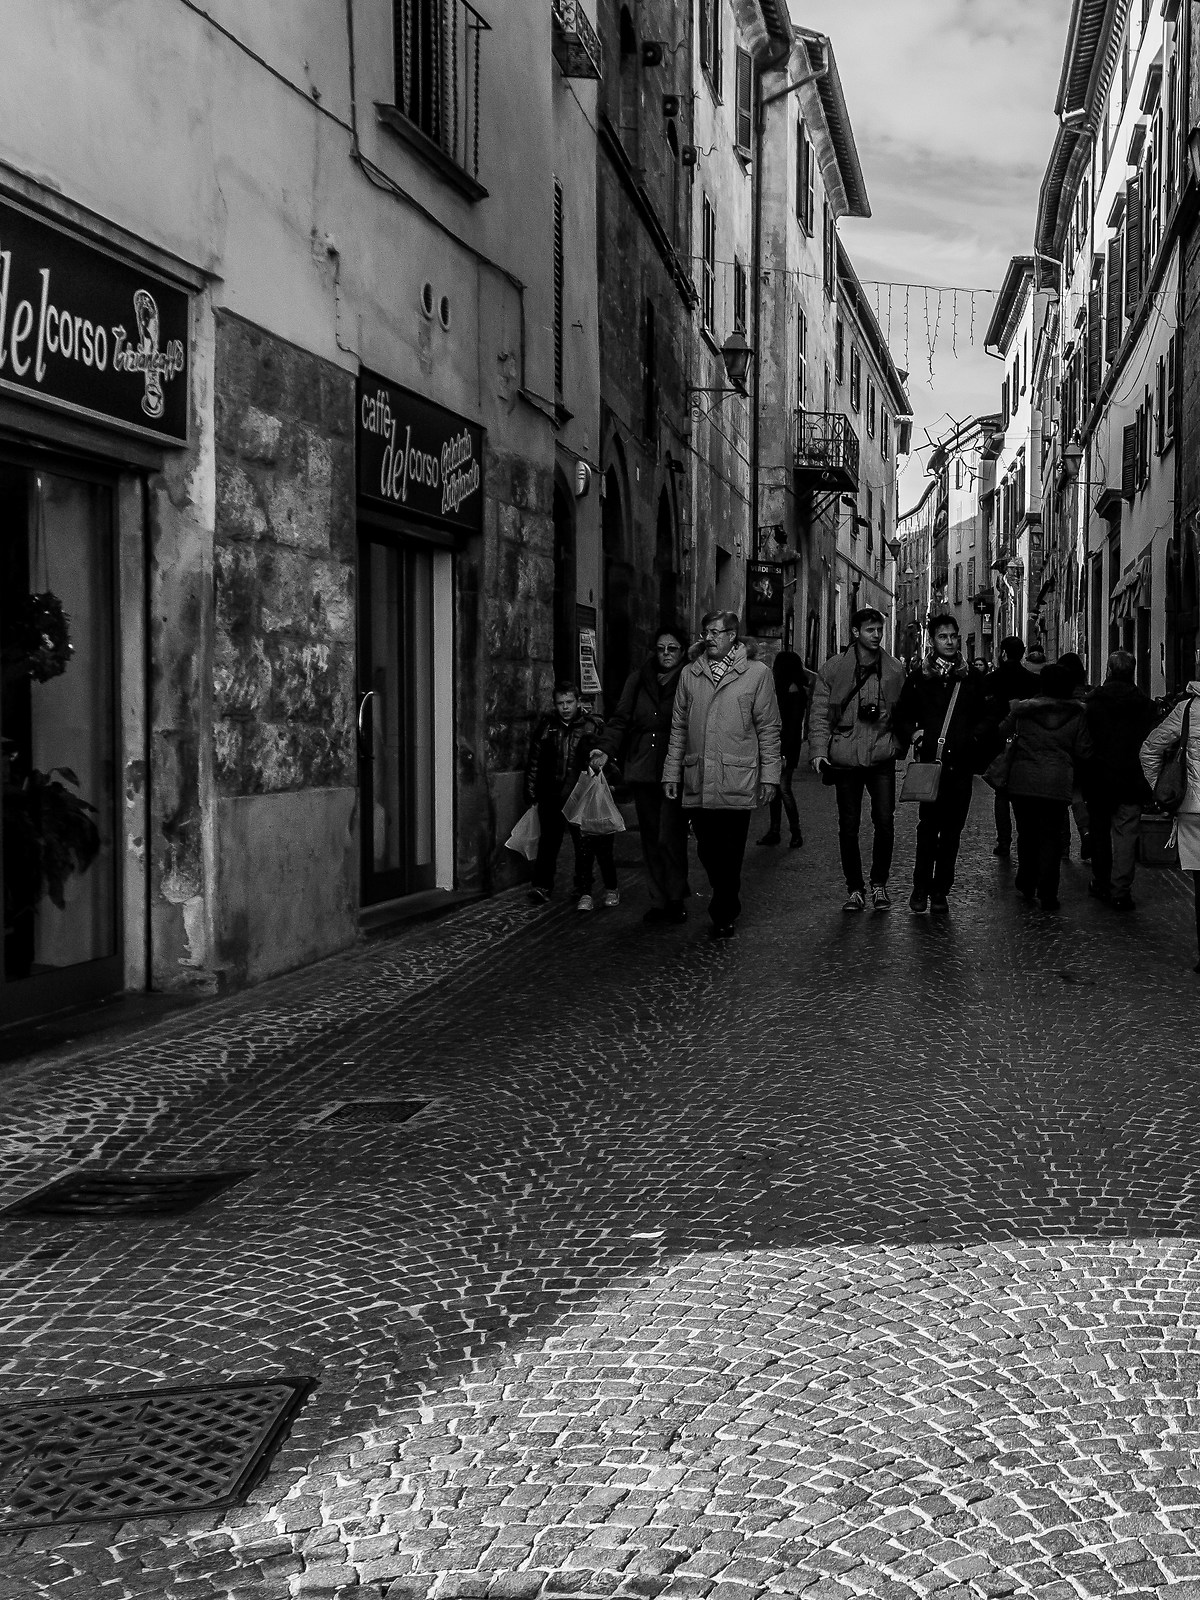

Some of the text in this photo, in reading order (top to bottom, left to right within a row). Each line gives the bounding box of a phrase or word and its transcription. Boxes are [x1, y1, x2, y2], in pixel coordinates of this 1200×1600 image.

[46, 305, 107, 371] corso
[362, 390, 391, 438] caffè
[381, 420, 439, 502] del corso
